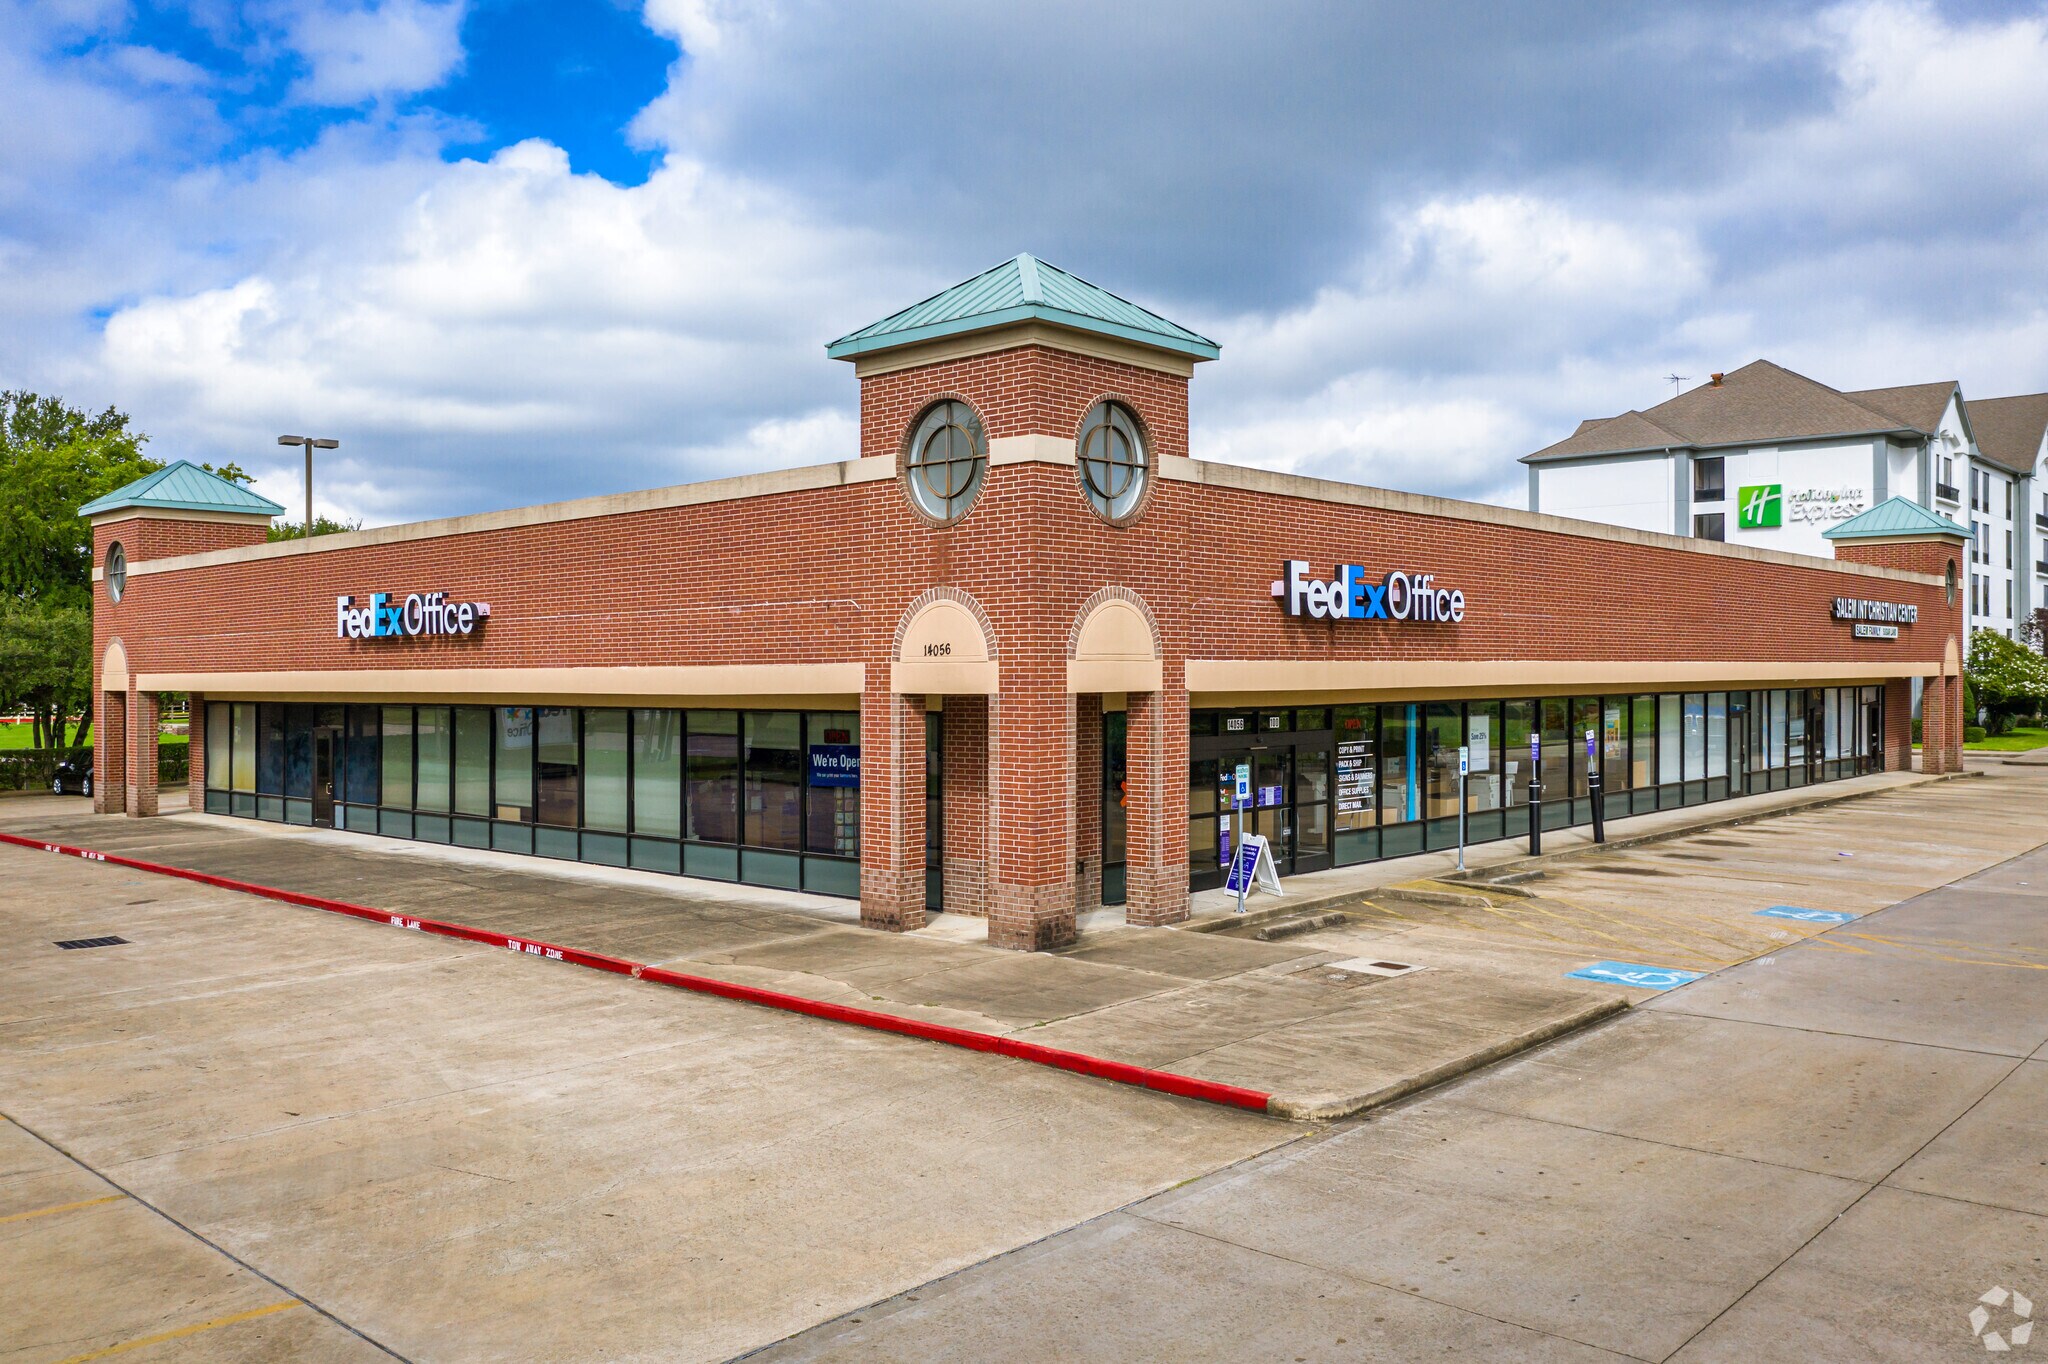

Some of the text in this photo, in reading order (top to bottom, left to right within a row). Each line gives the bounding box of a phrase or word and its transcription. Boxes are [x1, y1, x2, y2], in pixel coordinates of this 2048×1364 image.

[1789, 502, 1865, 525] Express
[1286, 560, 1465, 622] FedEx Office
[337, 591, 475, 639] FedEx Office
[1836, 597, 1918, 623] SALEM INT CHRISTIAN CENTER
[923, 643, 952, 657] 14056
[1227, 717, 1280, 731] 14056 100
[1344, 718, 1361, 730] OPEN
[826, 731, 849, 743] OPEN
[1338, 746, 1349, 754] COPY
[1353, 745, 1365, 753] PRINT
[812, 753, 838, 768] We're
[1338, 760, 1349, 768] PACK
[1353, 759, 1362, 767] SHIP
[1338, 774, 1351, 782] SIGNS
[1355, 771, 1373, 780] BANNERS
[1338, 786, 1369, 796] OFFICE SUPPLIES
[1338, 802, 1352, 810] DIRECT
[390, 916, 421, 930] FIRE LANE
[508, 939, 563, 960] TOW AWAY ZONE
